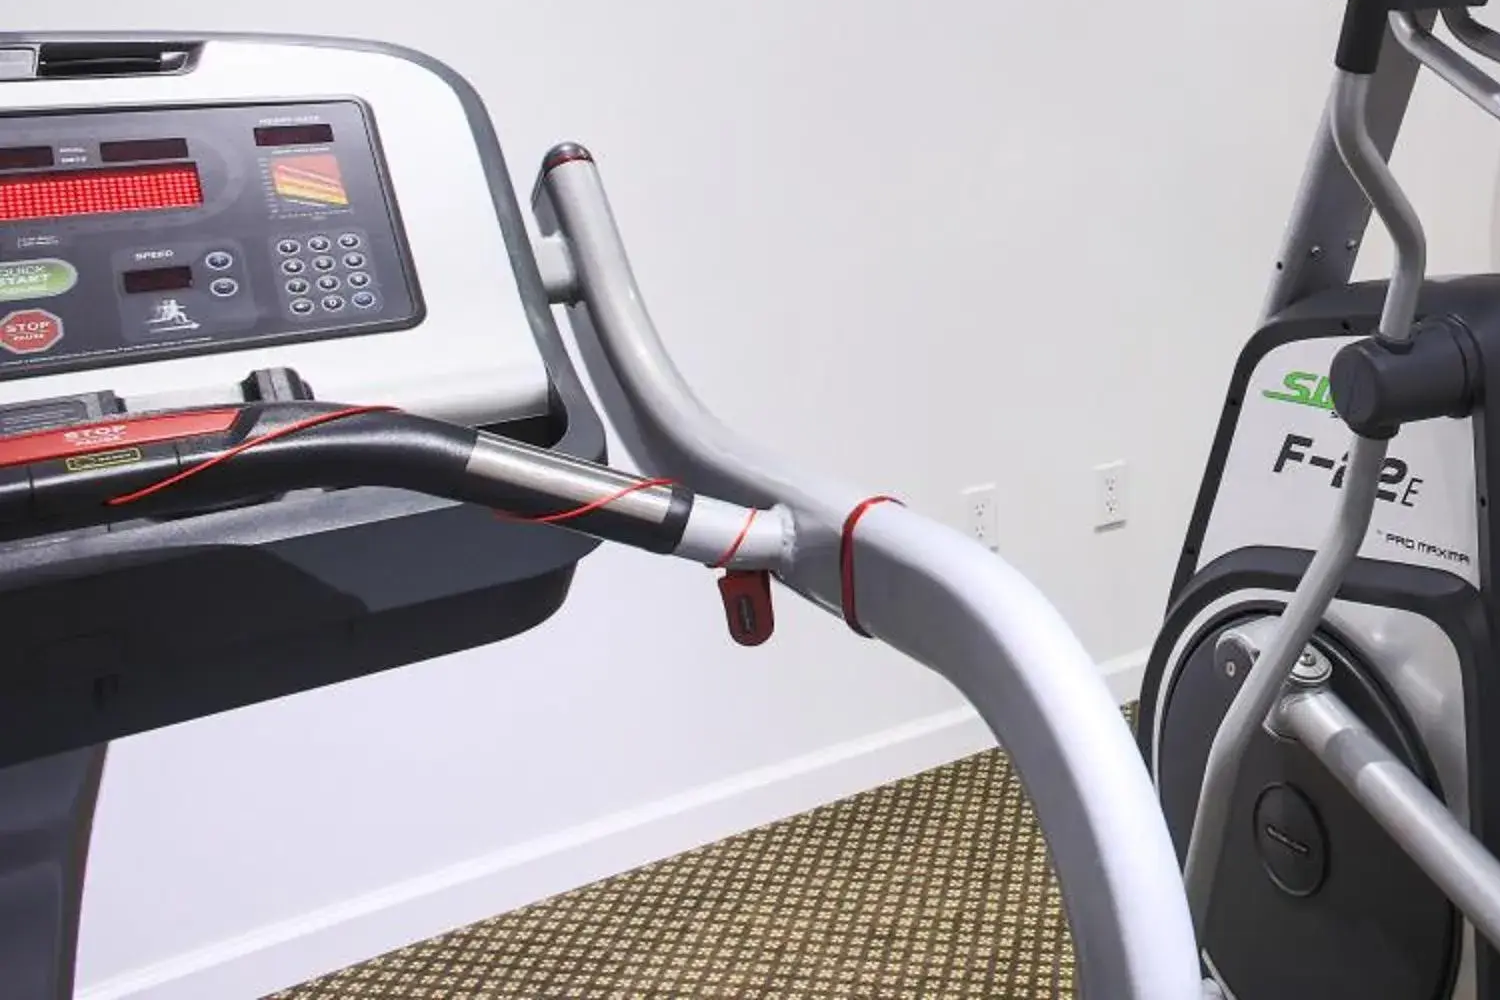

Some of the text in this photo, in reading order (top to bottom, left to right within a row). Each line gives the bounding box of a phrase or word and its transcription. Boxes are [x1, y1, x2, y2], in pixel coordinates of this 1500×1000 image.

[135, 249, 175, 262] SPEED
[5, 321, 51, 333] STOP
[63, 425, 127, 442] STOP
[1385, 533, 1471, 565] PRO MAXIMA
